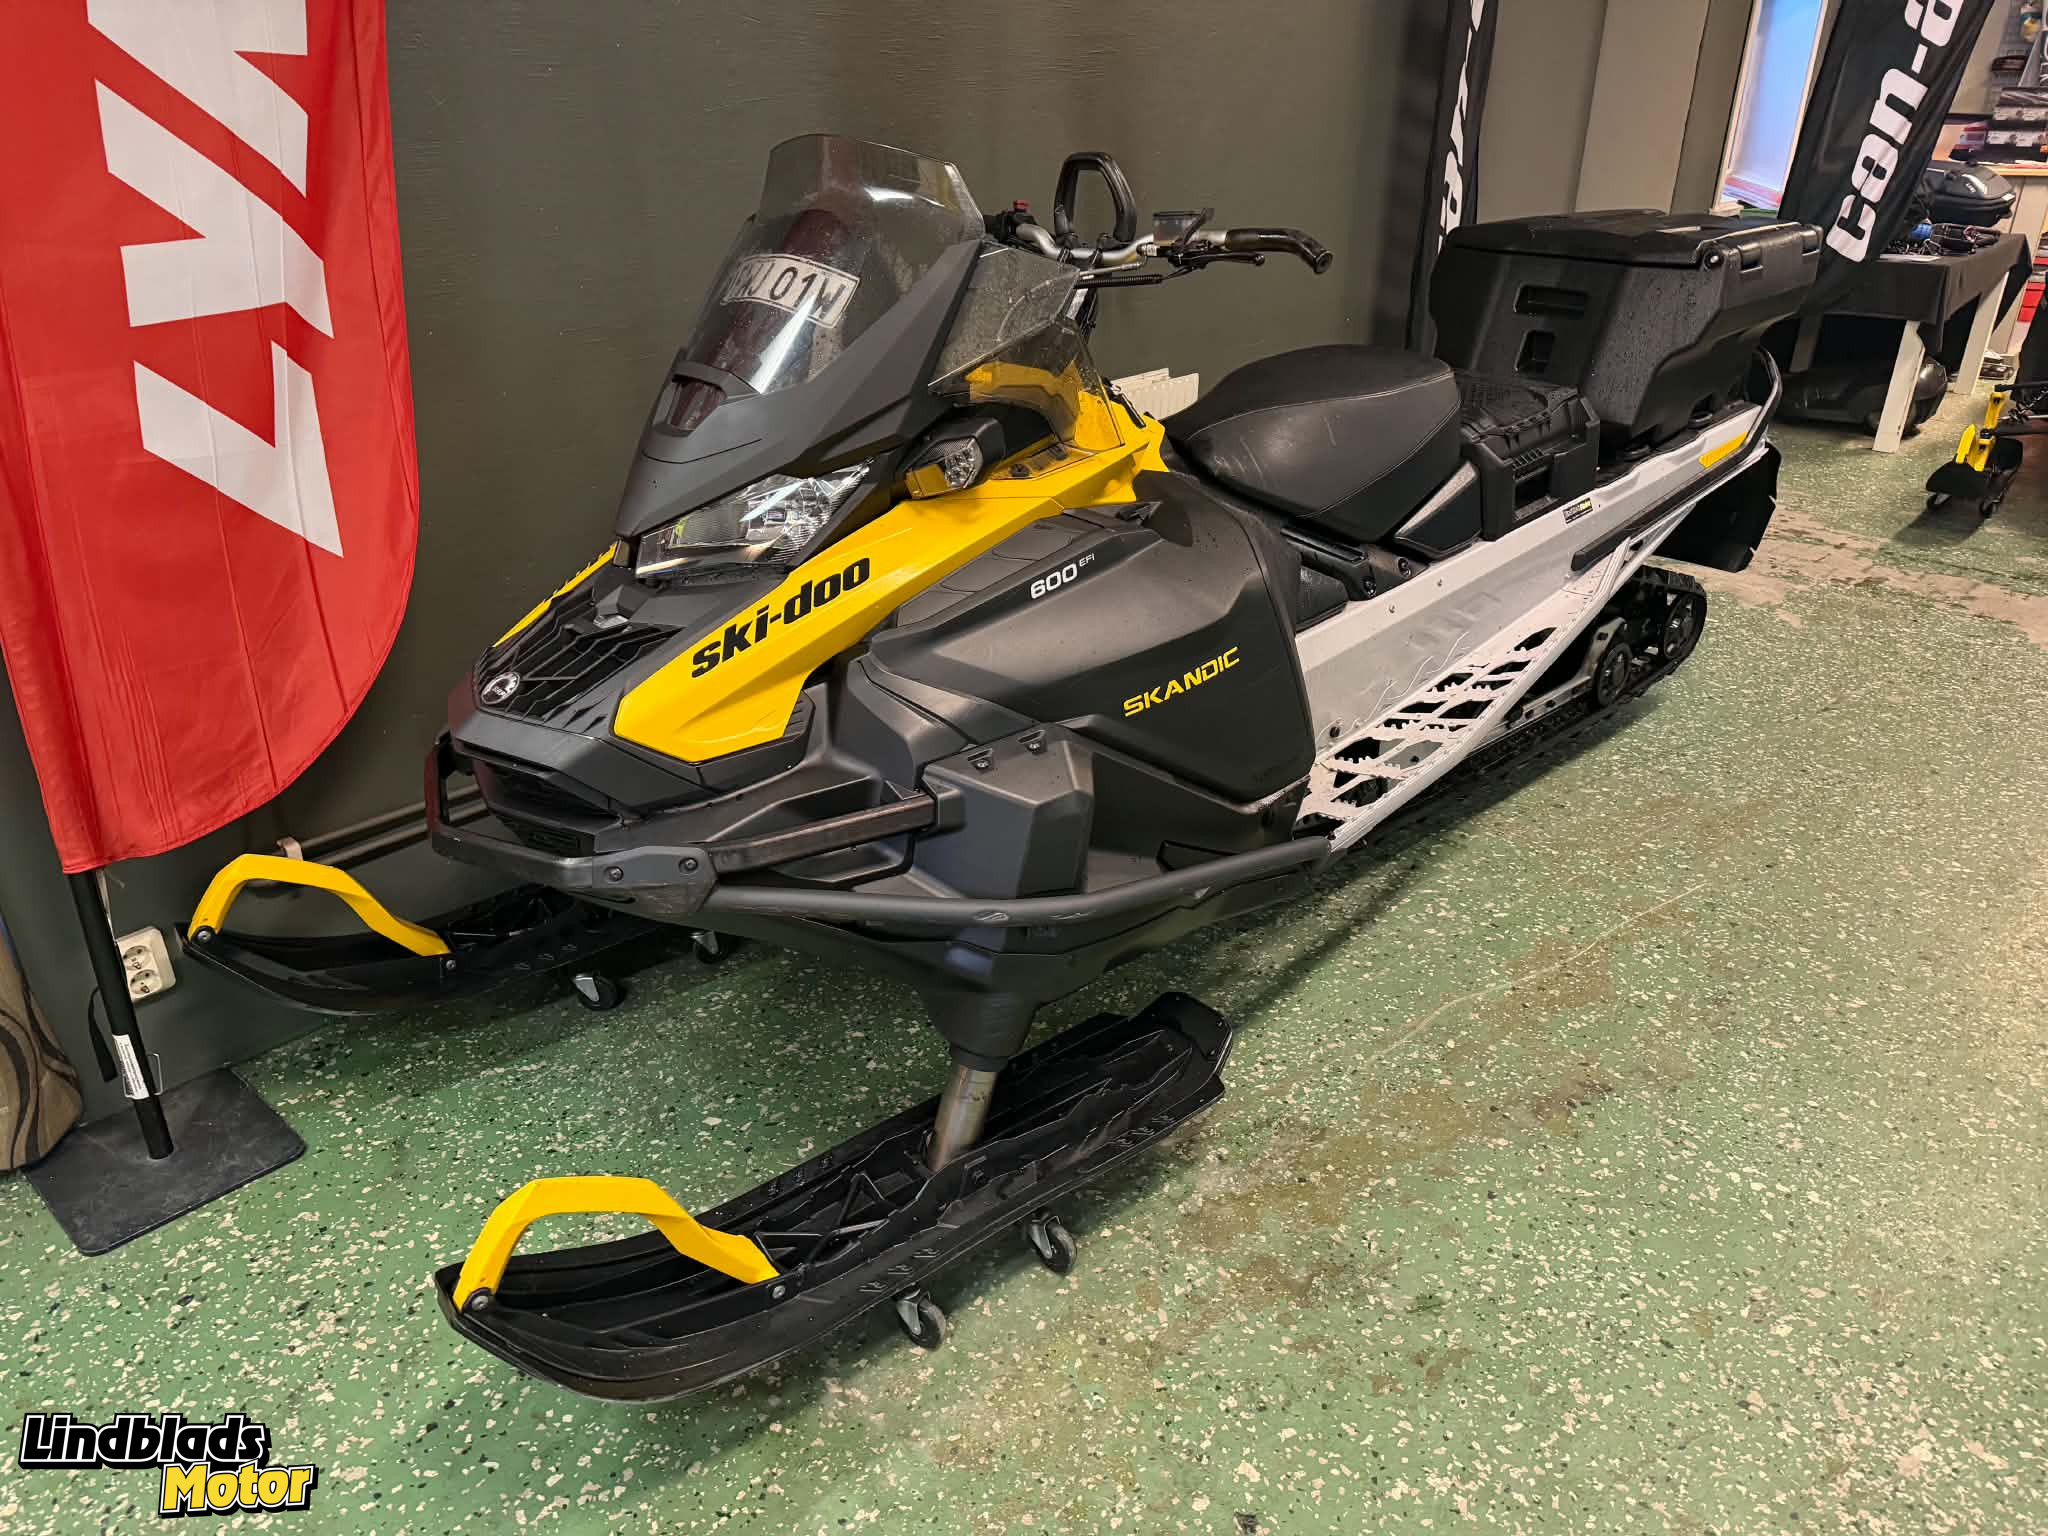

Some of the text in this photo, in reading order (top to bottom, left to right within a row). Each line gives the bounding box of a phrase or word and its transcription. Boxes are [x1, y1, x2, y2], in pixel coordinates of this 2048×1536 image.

[1030, 552, 1095, 599] 600 EFI
[1123, 646, 1240, 717] SKANDIC
